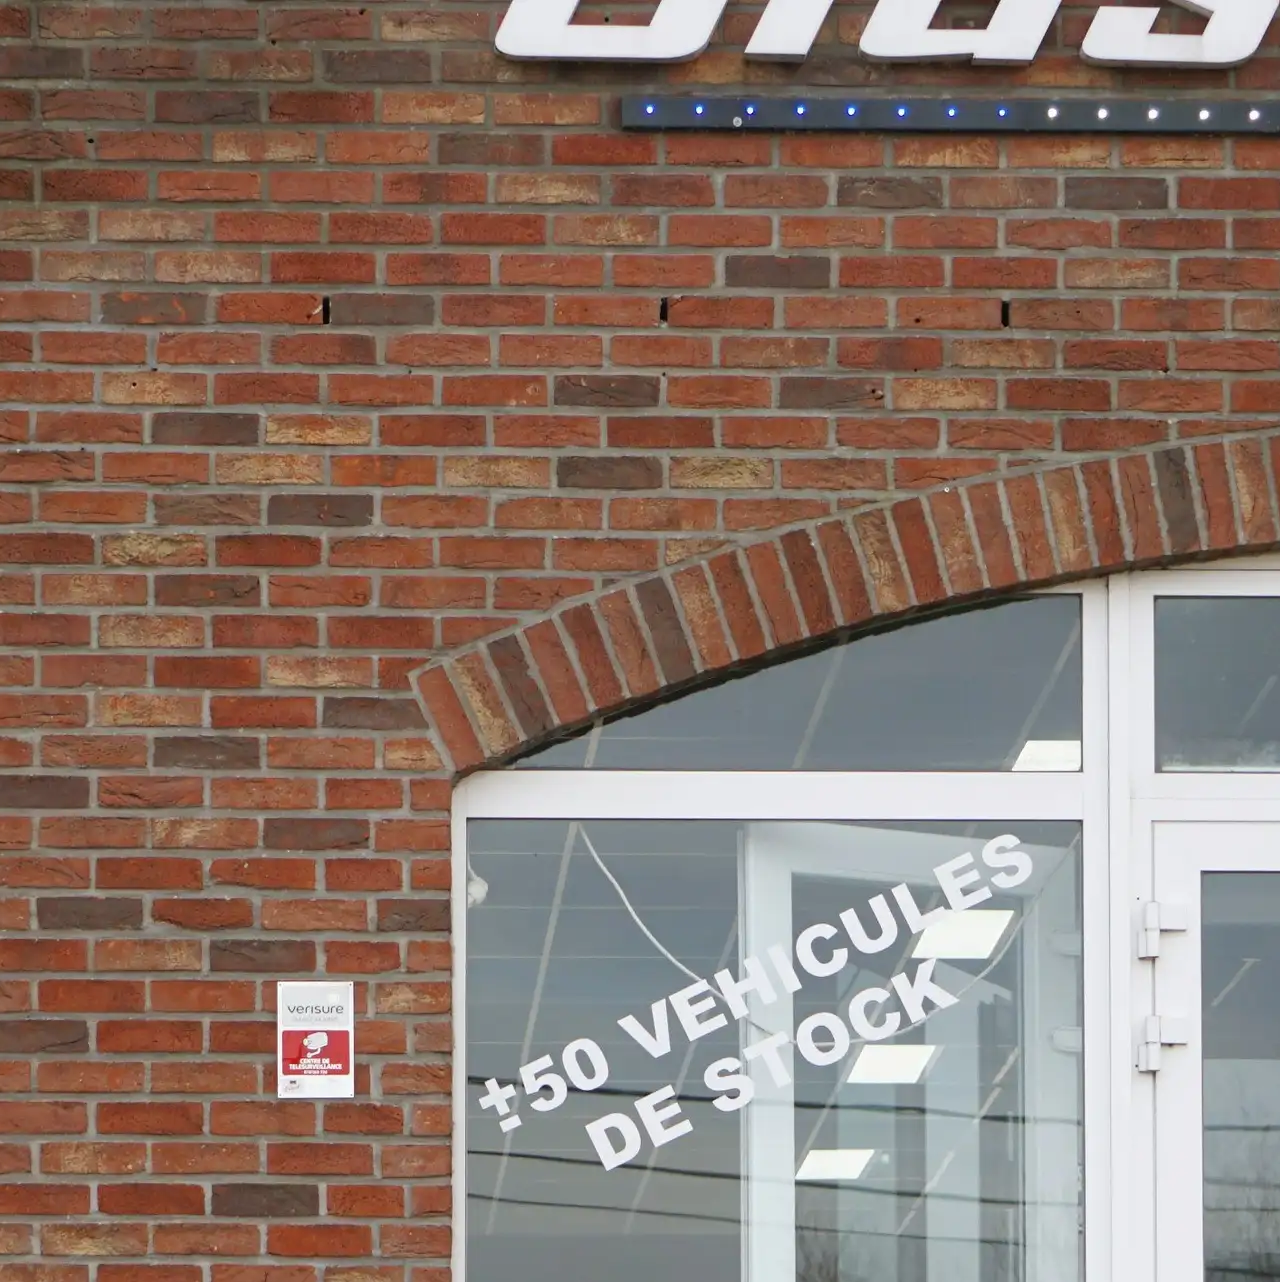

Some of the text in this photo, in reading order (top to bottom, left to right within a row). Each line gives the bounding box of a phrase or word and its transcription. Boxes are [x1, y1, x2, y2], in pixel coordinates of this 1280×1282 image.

[616, 833, 1034, 1060] VEHICULES
[584, 958, 961, 1172] DE STOCK
